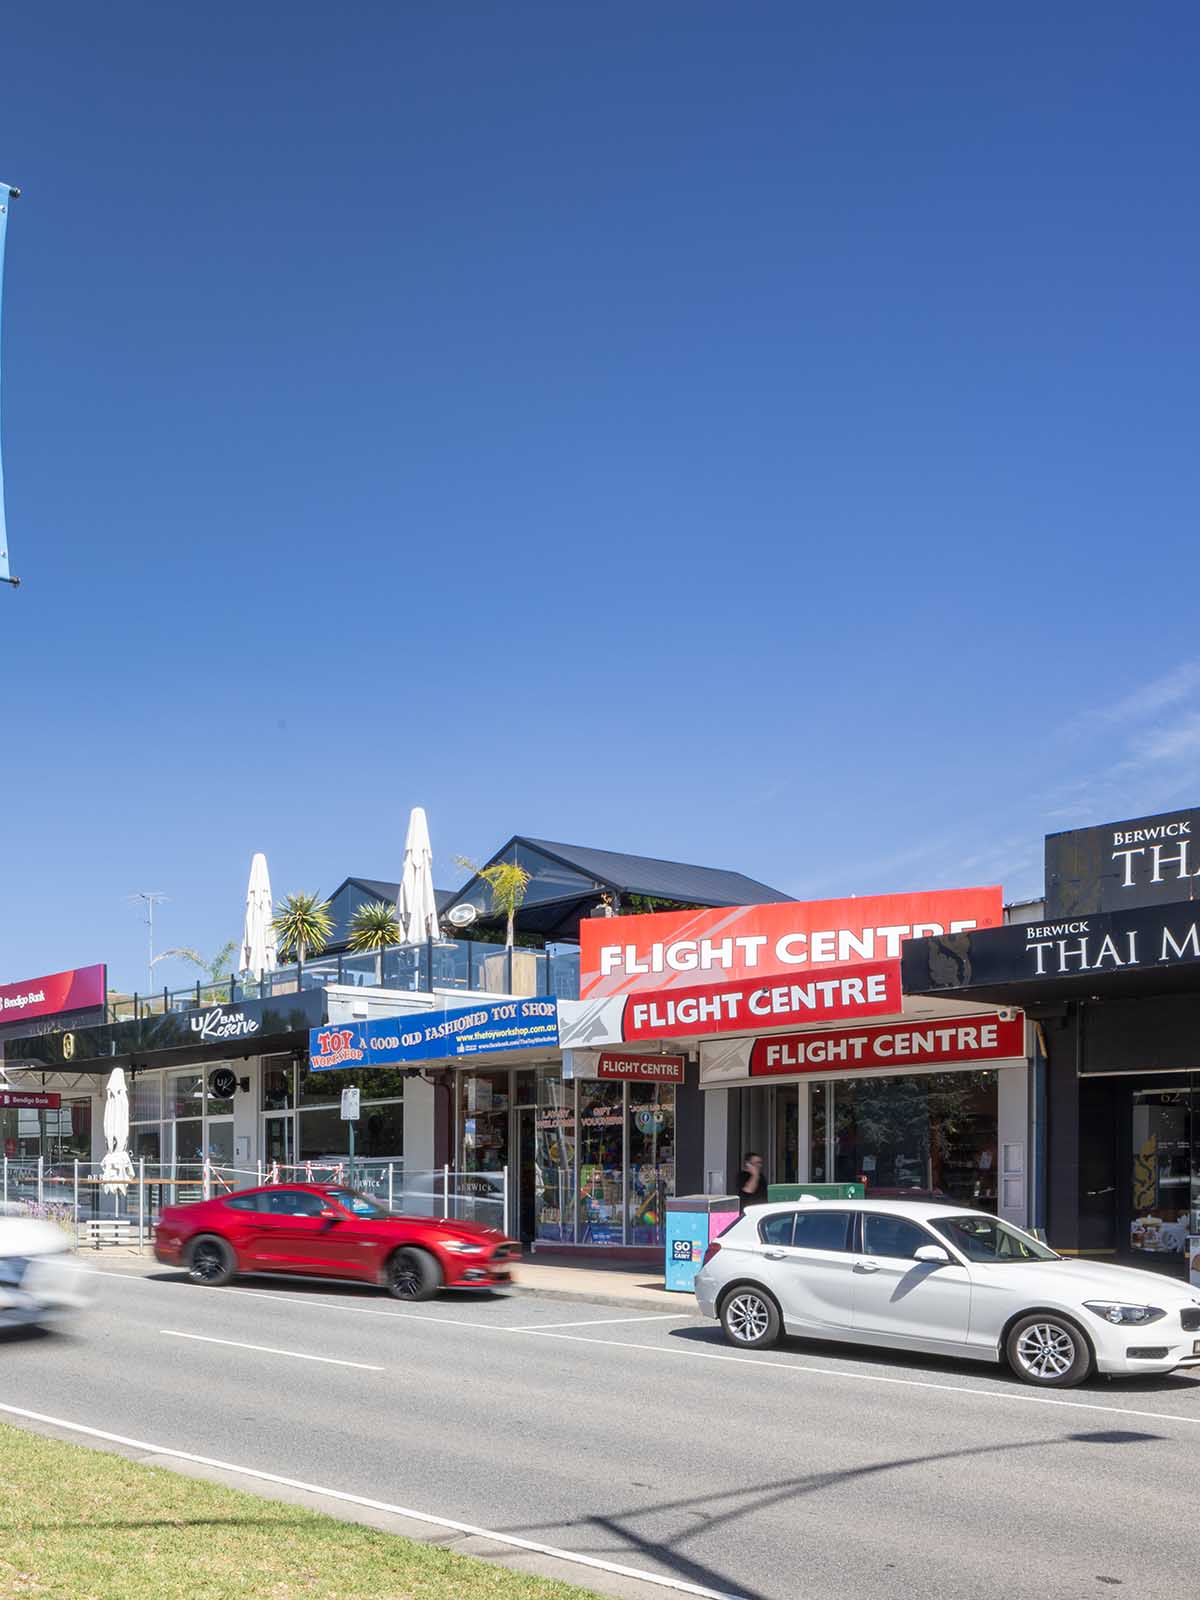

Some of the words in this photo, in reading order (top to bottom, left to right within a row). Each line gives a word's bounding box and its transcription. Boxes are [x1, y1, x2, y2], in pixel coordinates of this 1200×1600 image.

[1113, 821, 1191, 846] BERWICK
[1027, 921, 1090, 939] BERWICK
[600, 935, 768, 976] FLIGHT
[1026, 930, 1139, 975] THAI
[3, 994, 29, 1009] Bendigo
[28, 990, 46, 1004] Bank
[633, 993, 743, 1029] FLIGHT
[749, 974, 887, 1016] CENTRE
[359, 1038, 367, 1050] A
[370, 1036, 400, 1050] GOOD
[401, 1031, 422, 1046] OLD
[425, 1011, 489, 1041] FASHIONED
[491, 1004, 518, 1020] TOY
[521, 1002, 556, 1017] SHOP
[456, 1024, 557, 1042] www.thetoyworkshop.com.au
[317, 1030, 354, 1055] TOY
[767, 1037, 868, 1067] FLIGHT
[873, 1024, 998, 1057] CENTRE
[311, 1048, 364, 1068] WORKSHOP
[602, 1060, 640, 1073] FLIGHT
[640, 1063, 679, 1076] CENTRE
[12, 1096, 35, 1105] Bendigo
[35, 1097, 49, 1105] Bank
[674, 1241, 691, 1251] GO
